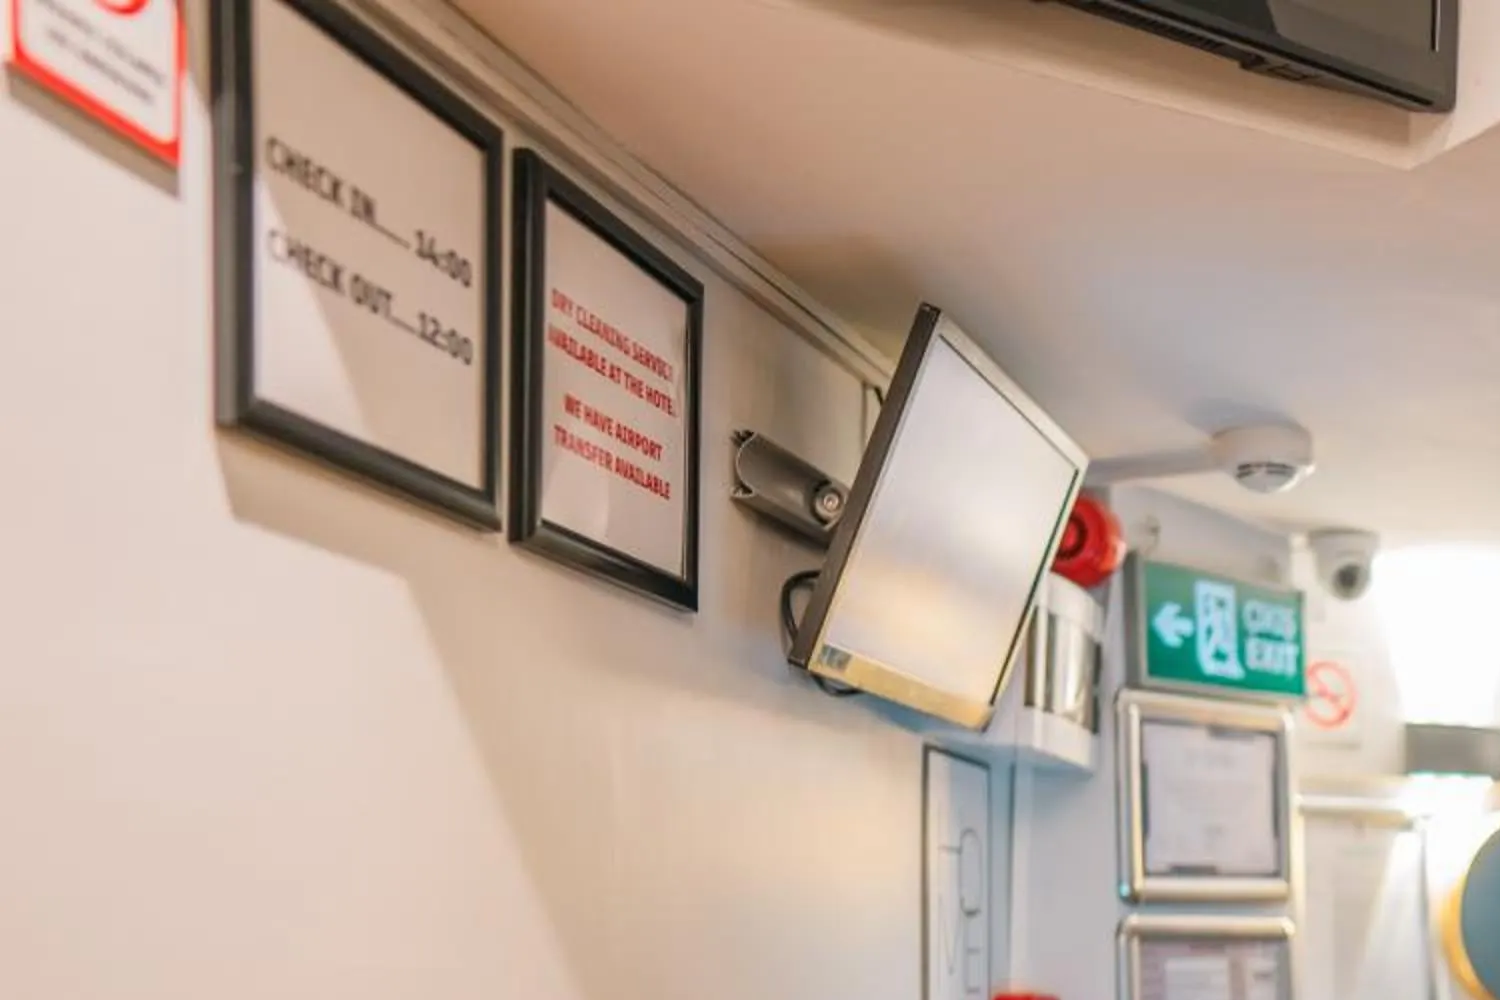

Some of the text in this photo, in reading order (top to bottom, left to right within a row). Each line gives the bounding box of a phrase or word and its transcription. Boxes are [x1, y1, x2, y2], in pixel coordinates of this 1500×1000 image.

[265, 136, 473, 288] CHECK IN 14:00
[267, 229, 474, 366] CHECK OUT 12:00
[552, 287, 574, 317] DRY
[576, 305, 631, 355] CLEANING
[548, 323, 606, 377] AVAILABLE
[609, 363, 621, 385] AT
[624, 371, 644, 399] THE
[554, 423, 671, 500] TRANSFER AVAILABLE
[564, 393, 663, 462] WE HAVE AIRPORT
[1245, 637, 1300, 678] EXIT
